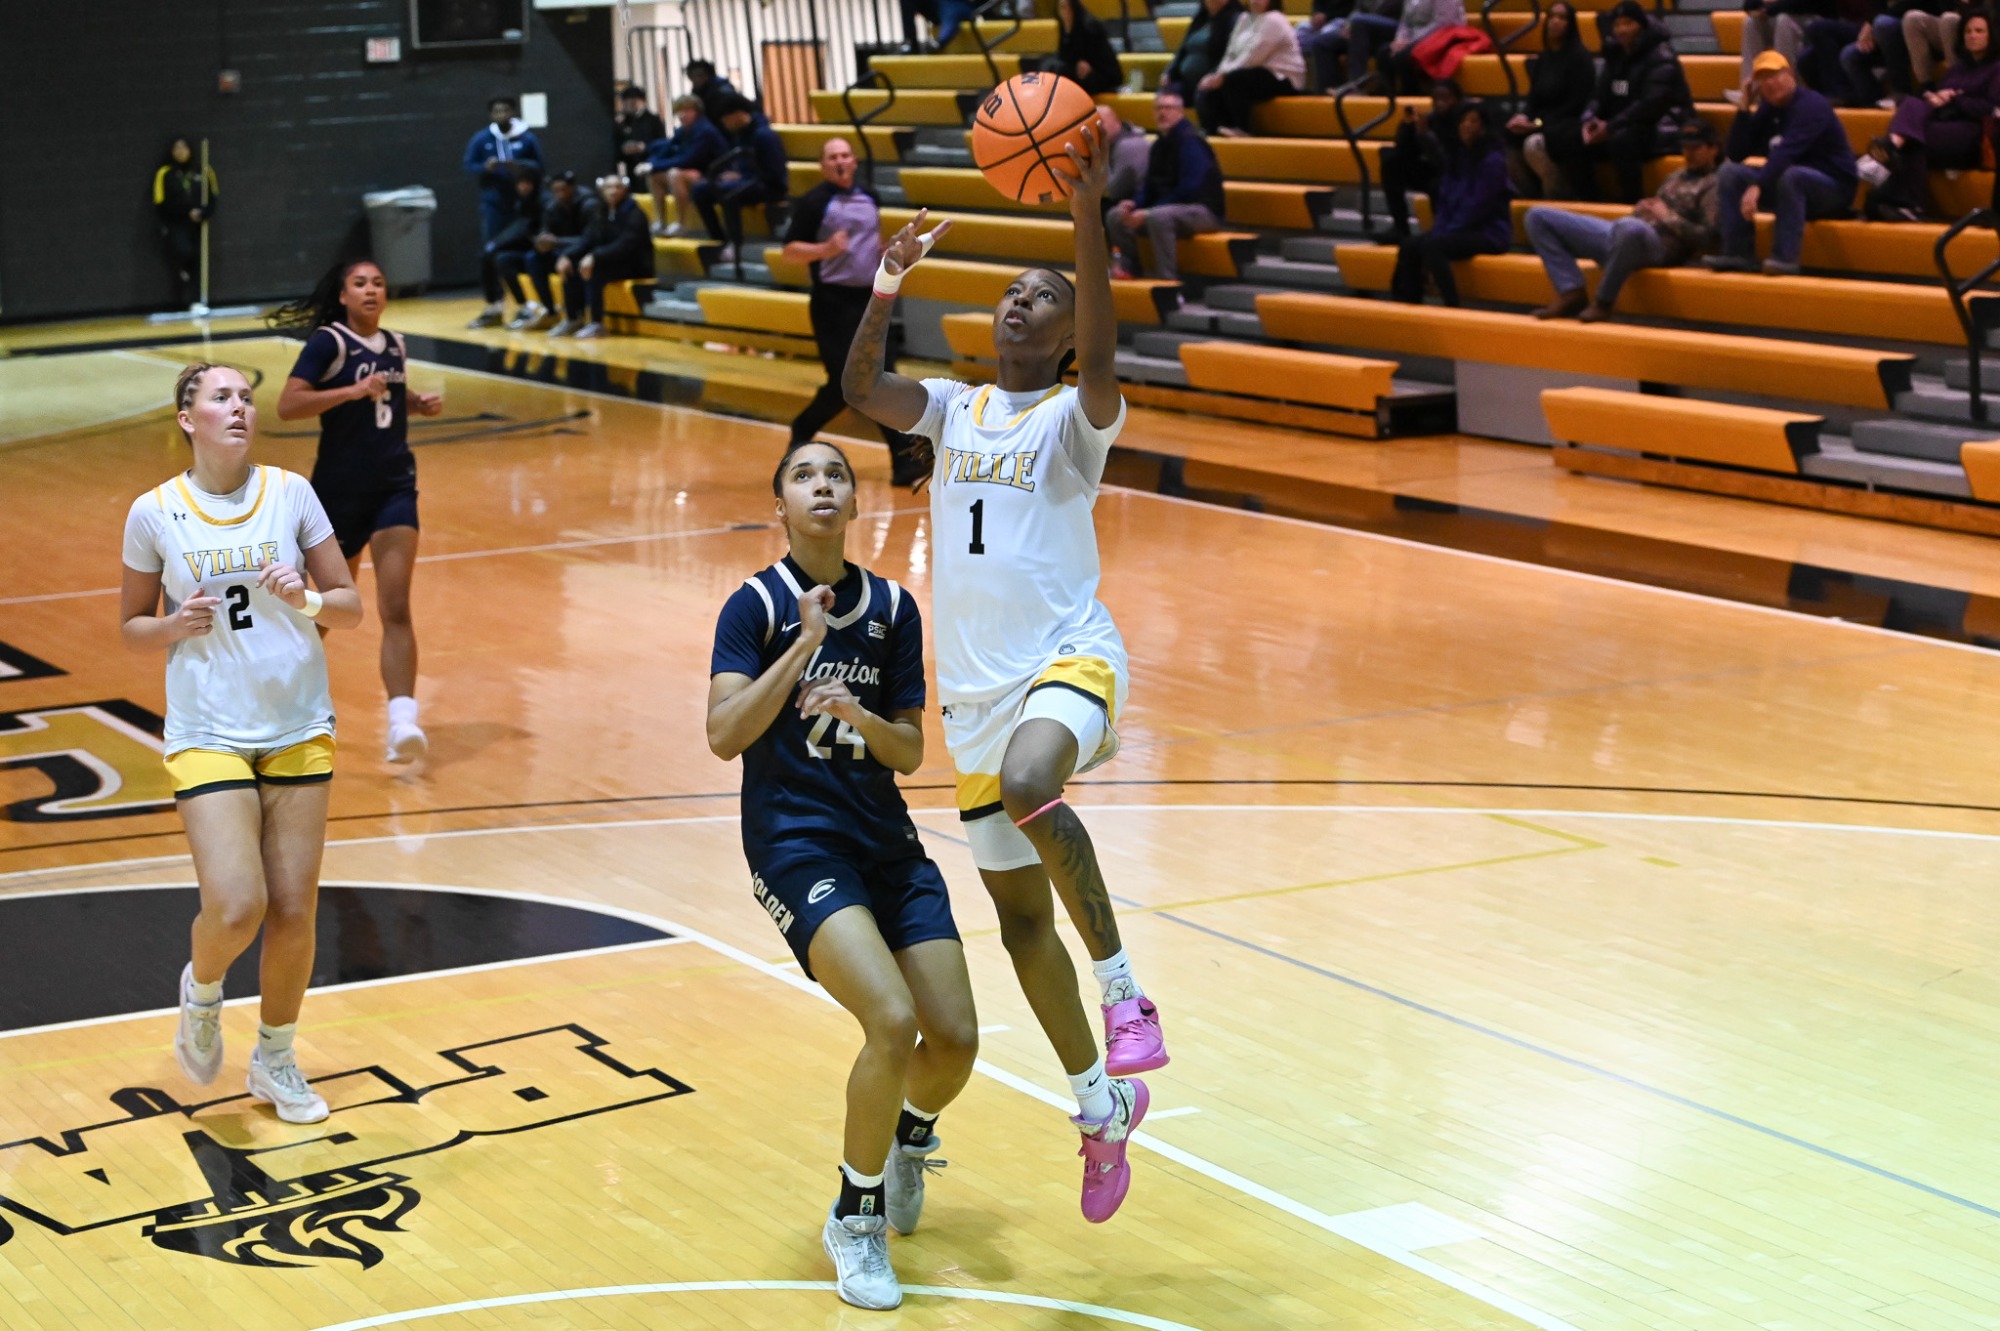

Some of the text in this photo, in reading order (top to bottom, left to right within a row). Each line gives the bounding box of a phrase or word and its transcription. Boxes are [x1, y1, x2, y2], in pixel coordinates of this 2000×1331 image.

[375, 388, 393, 429] 6
[943, 446, 1037, 493] VILLE
[969, 498, 985, 555] 1
[183, 541, 280, 582] VILLE
[225, 585, 253, 631] 2
[797, 645, 880, 686] larion
[806, 696, 862, 760] 24
